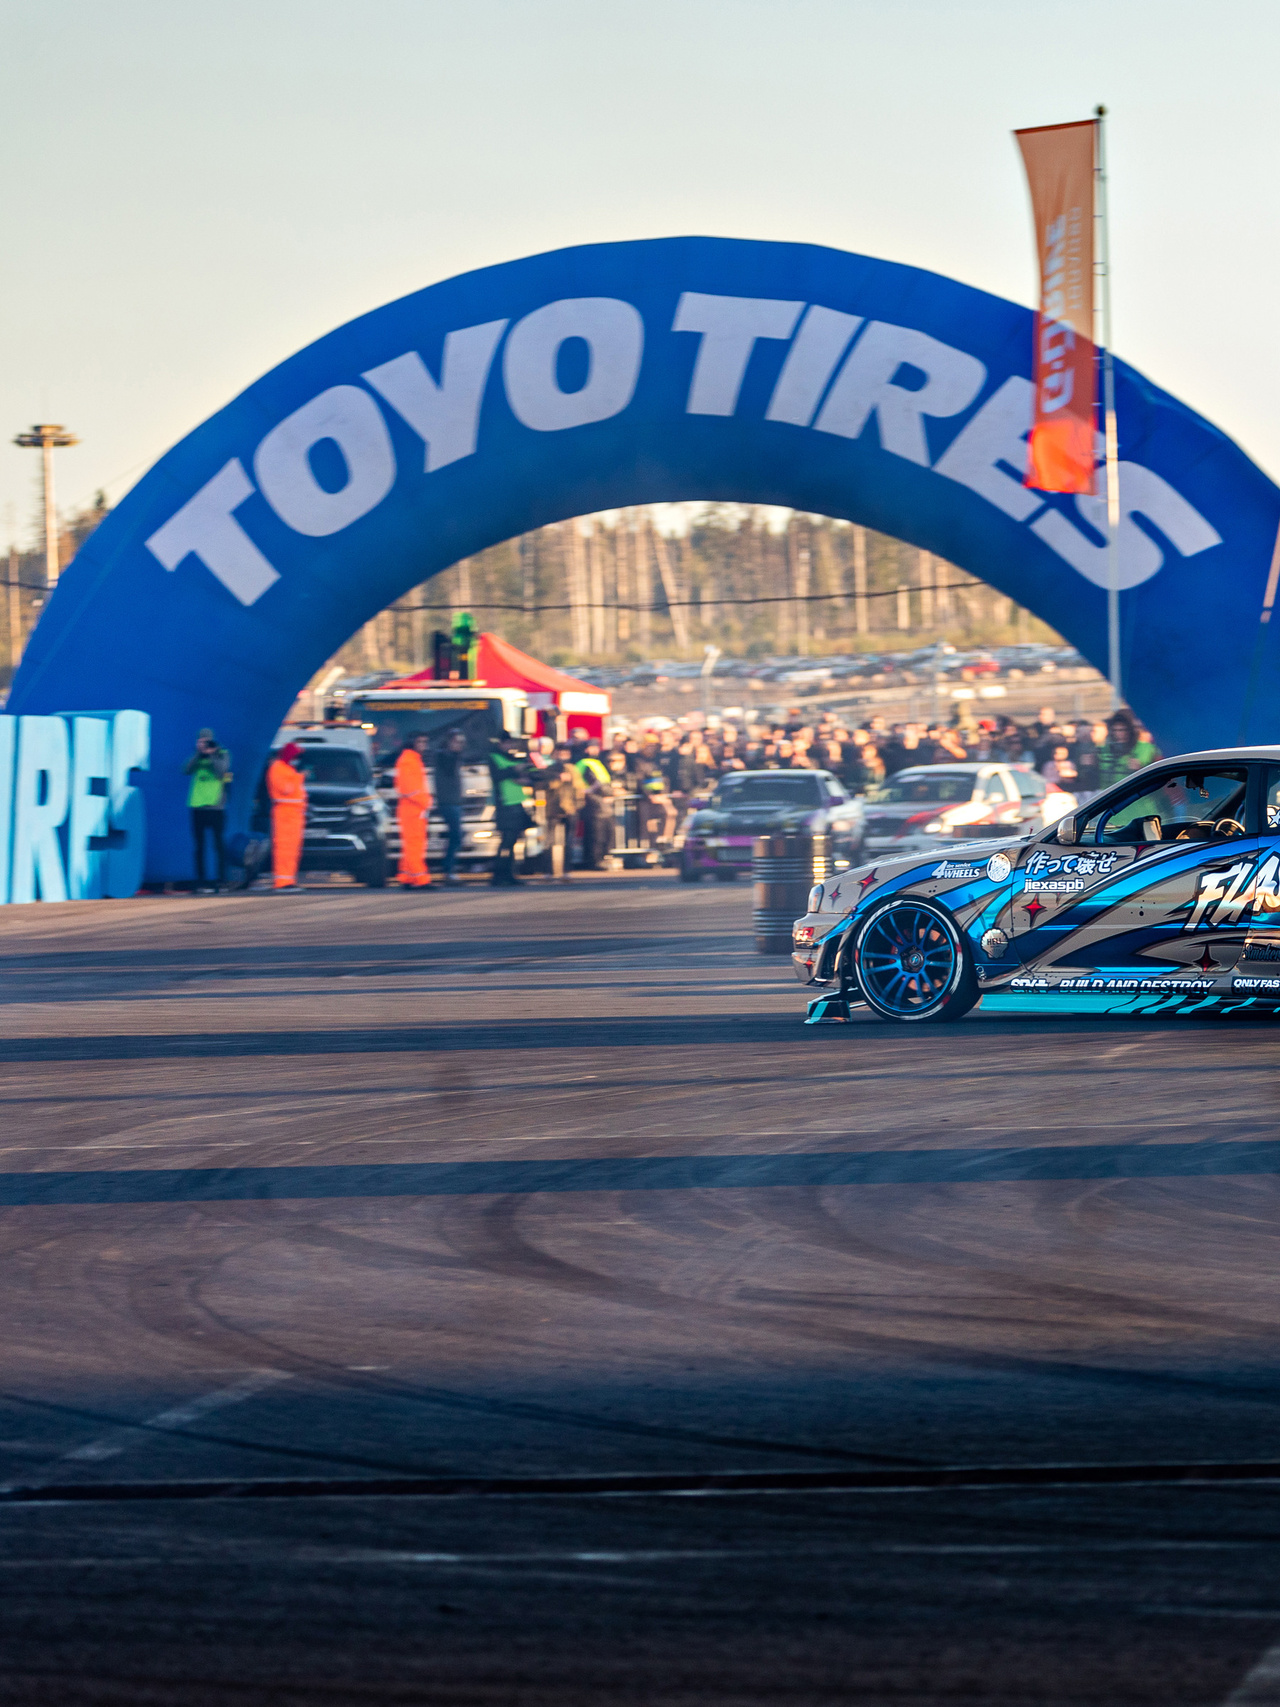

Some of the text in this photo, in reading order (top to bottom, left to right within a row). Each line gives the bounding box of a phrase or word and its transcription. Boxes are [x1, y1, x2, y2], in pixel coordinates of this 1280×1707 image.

[145, 291, 1223, 606] TOYO TIRES
[1024, 851, 1117, 875] 作って壊せ
